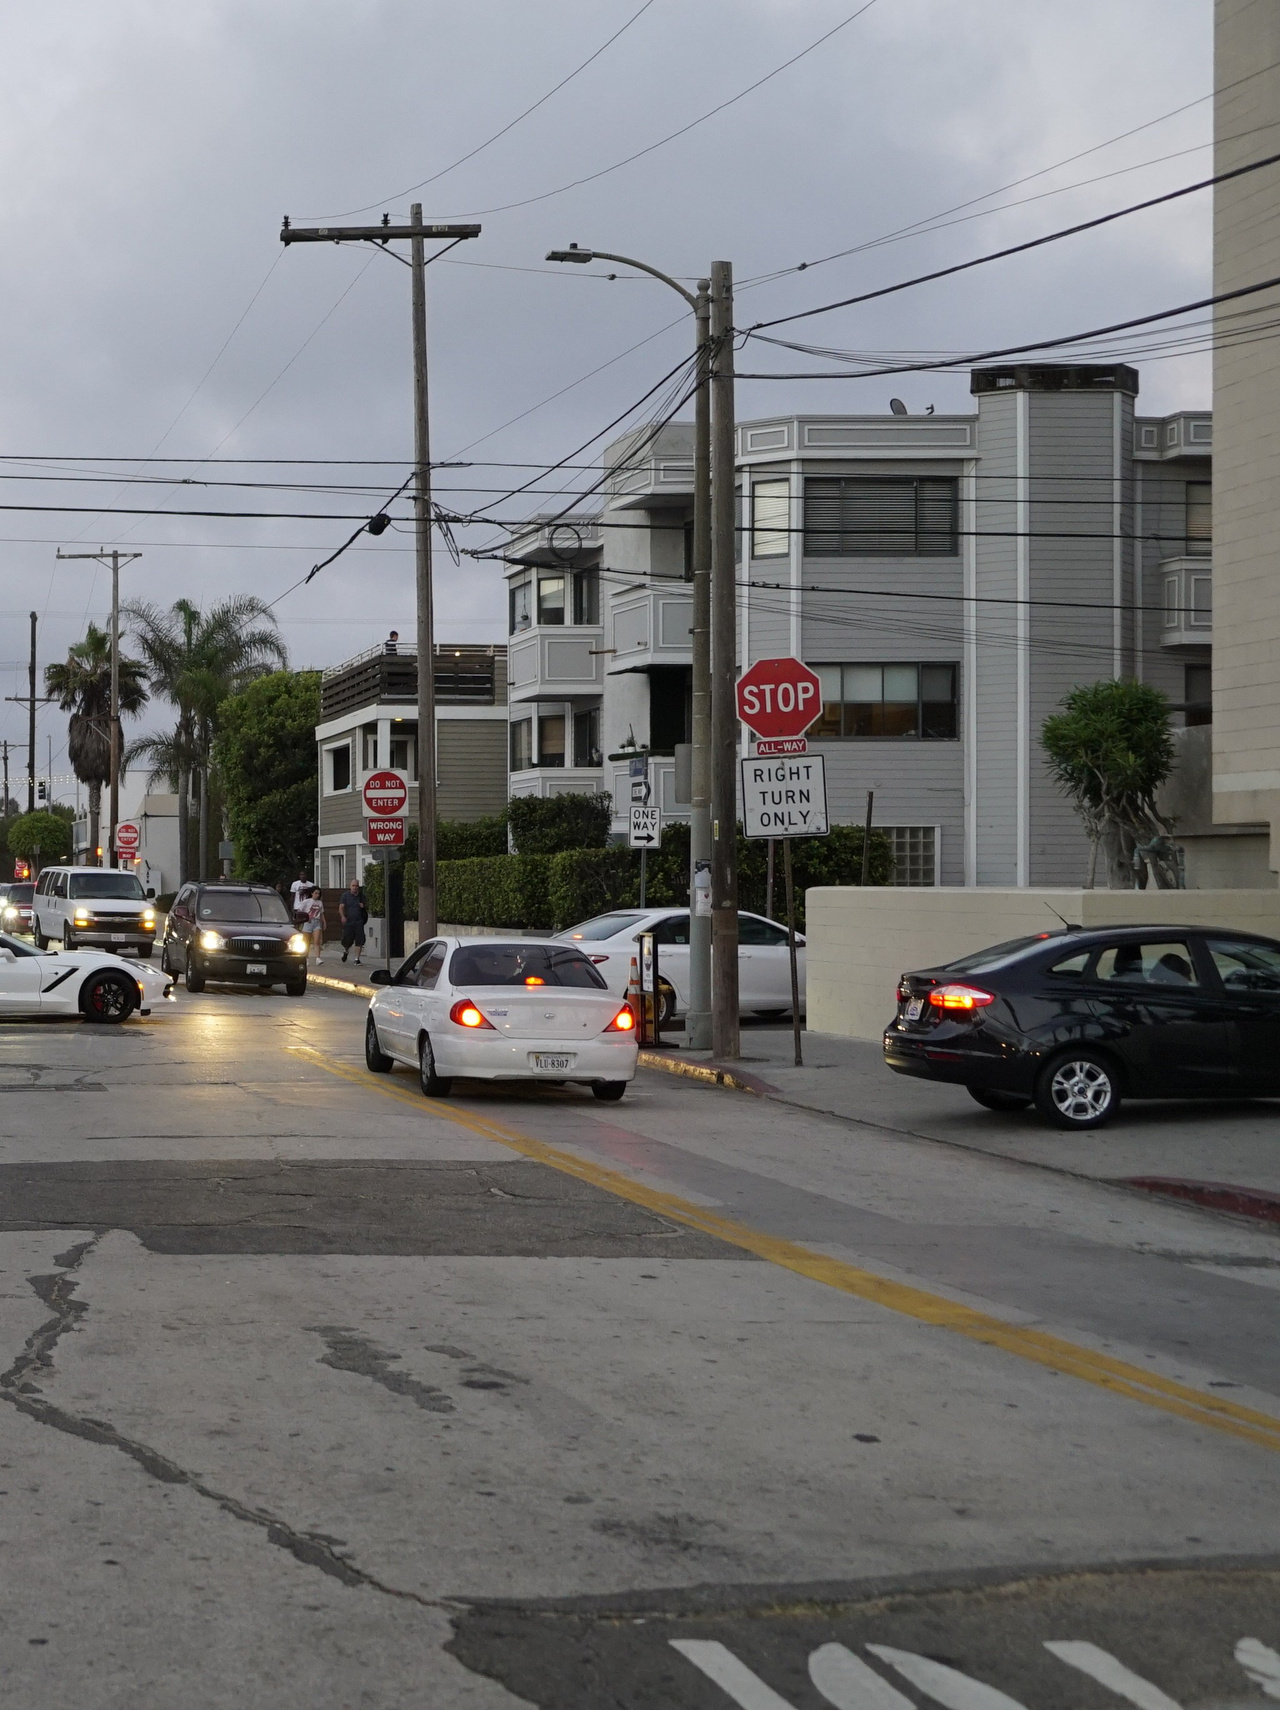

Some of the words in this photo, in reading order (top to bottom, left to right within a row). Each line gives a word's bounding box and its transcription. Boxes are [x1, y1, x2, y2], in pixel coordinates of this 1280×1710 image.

[743, 681, 815, 715] STOP
[758, 741, 805, 754] ALL-WAY
[754, 766, 812, 783] RIGHT
[369, 780, 380, 788] DO
[372, 799, 398, 807] ENTER
[759, 789, 810, 806] TURN
[633, 810, 657, 820] ONE
[760, 810, 810, 827] ONLY
[633, 821, 657, 831] WAY
[376, 833, 396, 841] WAY
